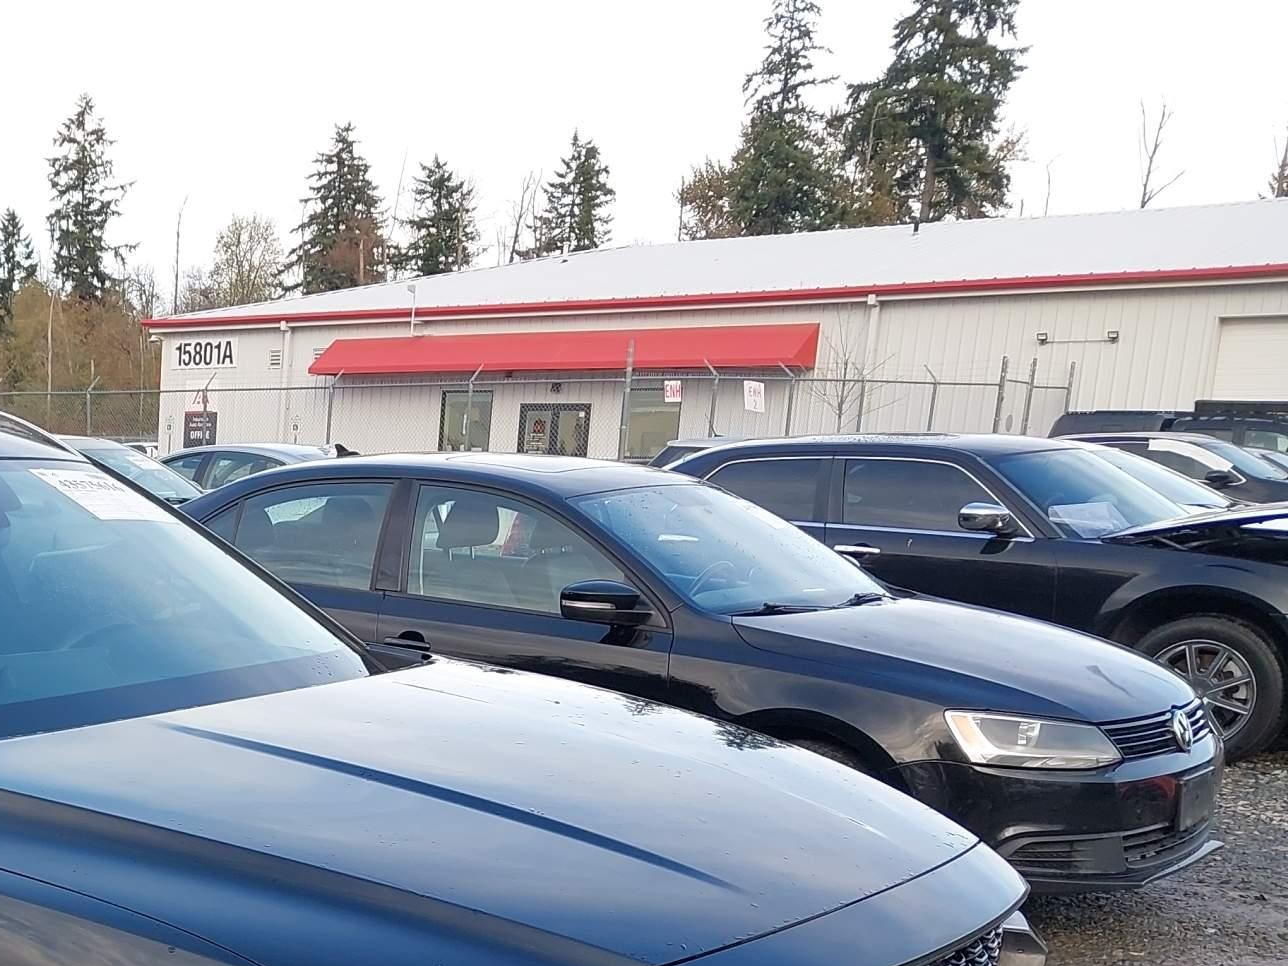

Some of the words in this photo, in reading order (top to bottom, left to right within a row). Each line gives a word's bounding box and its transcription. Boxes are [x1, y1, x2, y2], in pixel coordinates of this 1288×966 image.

[175, 340, 234, 367] 15801A
[665, 383, 681, 399] ENH
[190, 430, 210, 440] OFFIE
